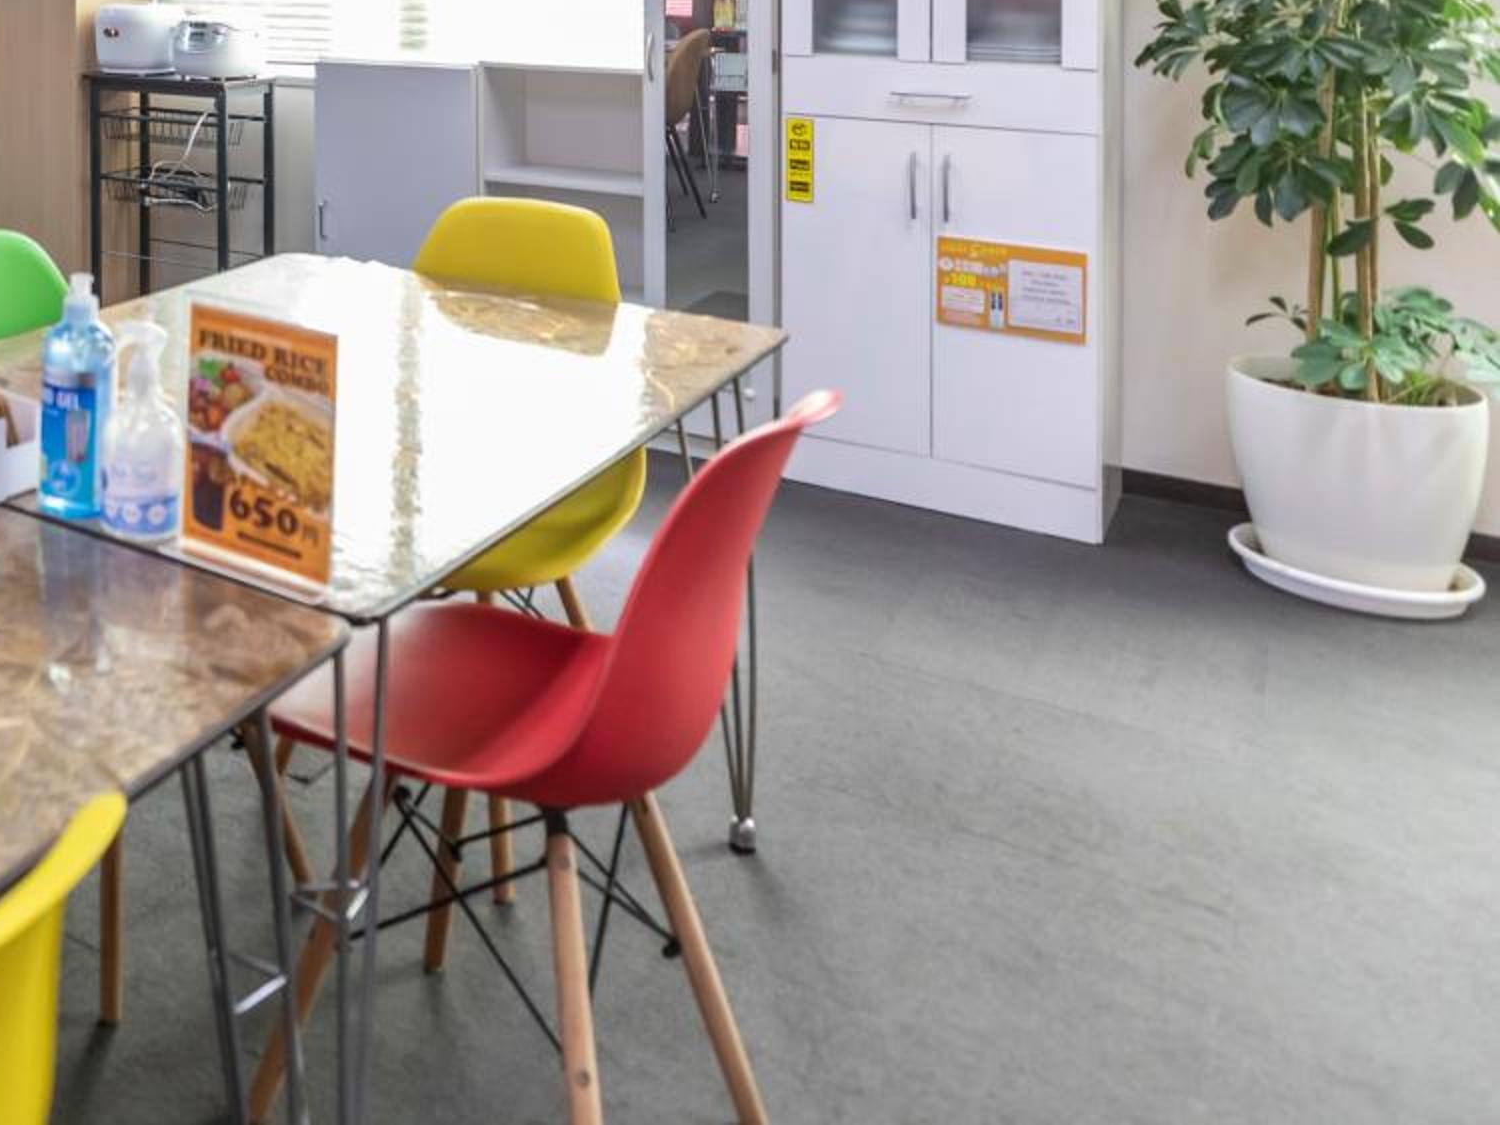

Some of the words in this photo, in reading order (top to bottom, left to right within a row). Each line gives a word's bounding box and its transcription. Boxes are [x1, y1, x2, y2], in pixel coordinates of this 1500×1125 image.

[198, 329, 266, 360] FRIED
[274, 346, 326, 374] RICE
[264, 364, 330, 394] COMBO
